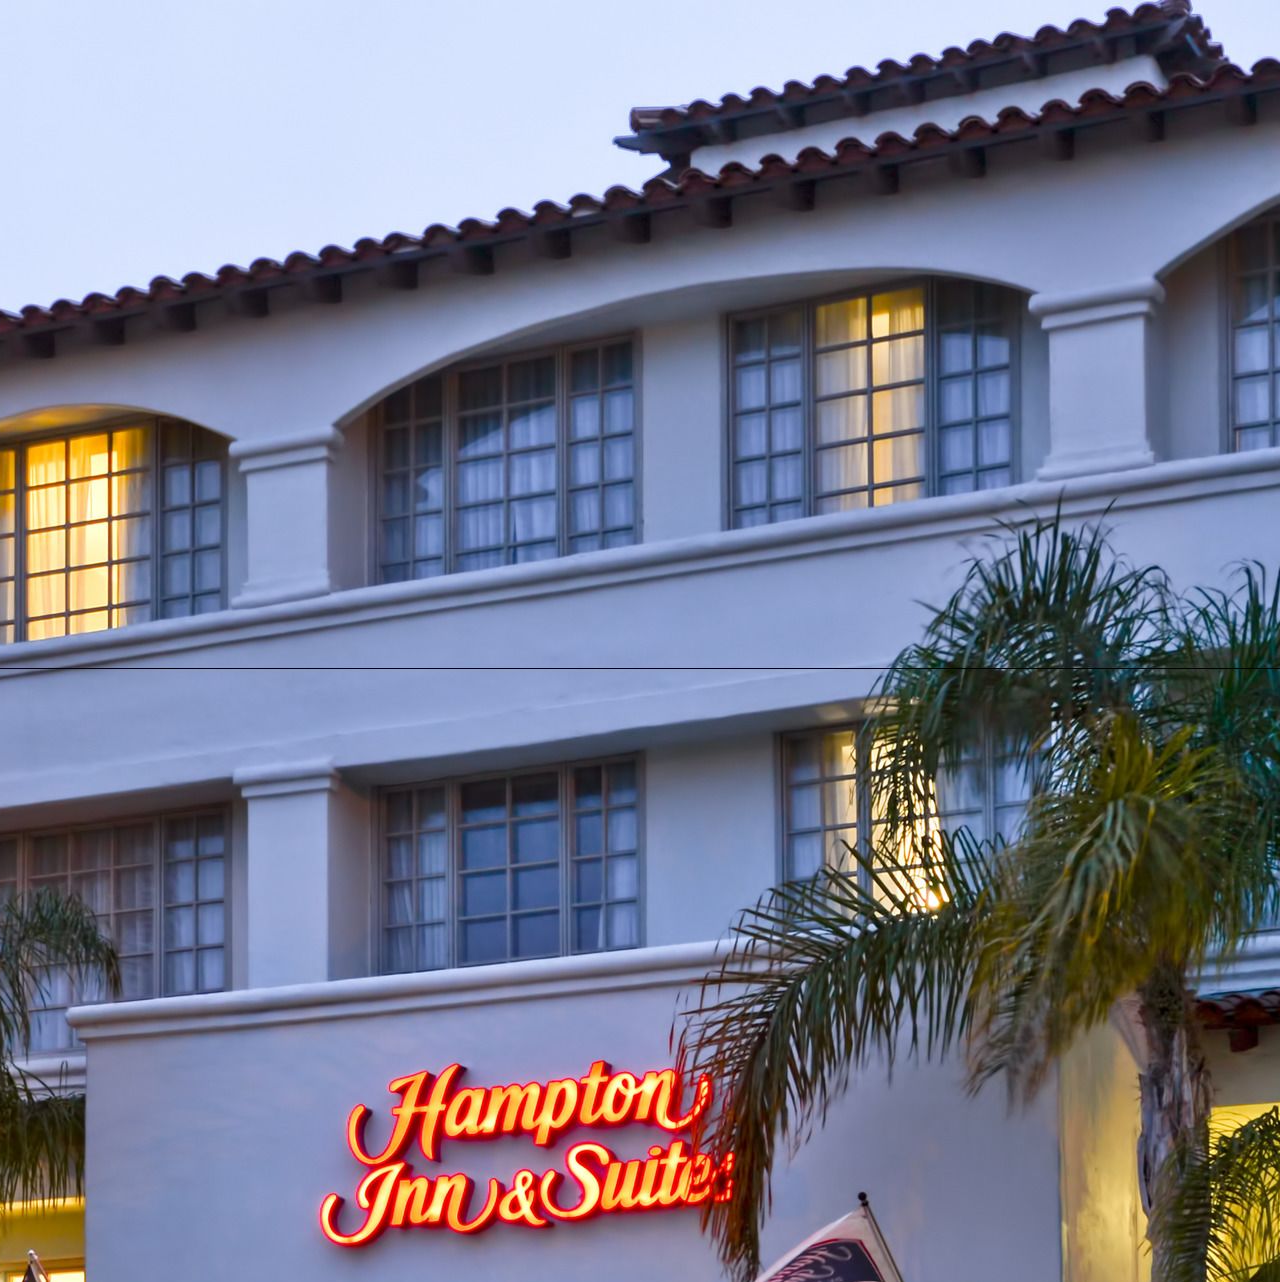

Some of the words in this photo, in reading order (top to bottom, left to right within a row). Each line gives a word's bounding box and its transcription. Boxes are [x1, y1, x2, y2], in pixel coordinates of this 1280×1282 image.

[347, 1060, 713, 1164] Hampton
[320, 1161, 501, 1247] Inn
[498, 1168, 549, 1229] &
